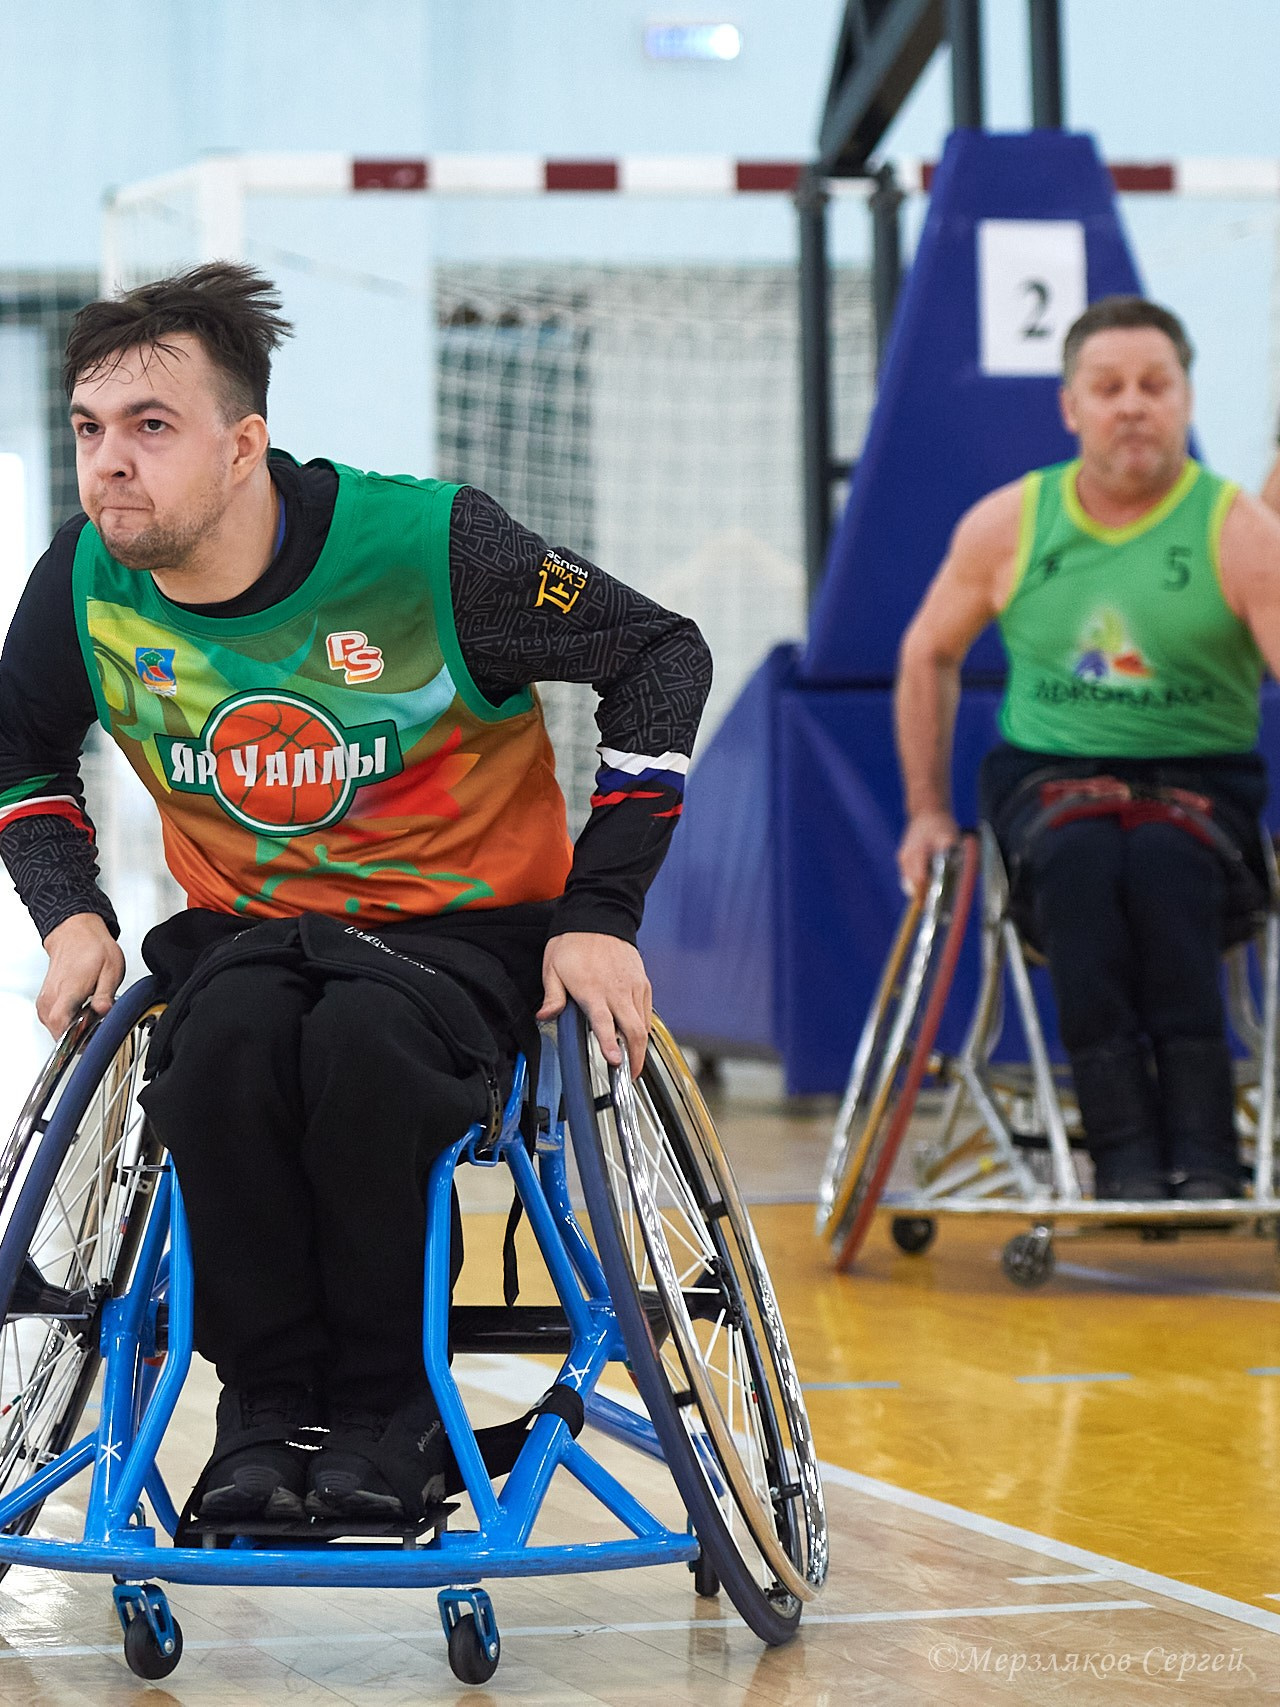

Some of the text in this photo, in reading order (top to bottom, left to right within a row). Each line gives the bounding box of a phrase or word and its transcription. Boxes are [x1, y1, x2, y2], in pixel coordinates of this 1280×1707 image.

[1020, 277, 1051, 338] 2
[546, 549, 589, 579] HOUSE
[1164, 546, 1193, 592] 5
[326, 632, 384, 683] PS
[230, 736, 387, 787] ЧАЛЛЫ
